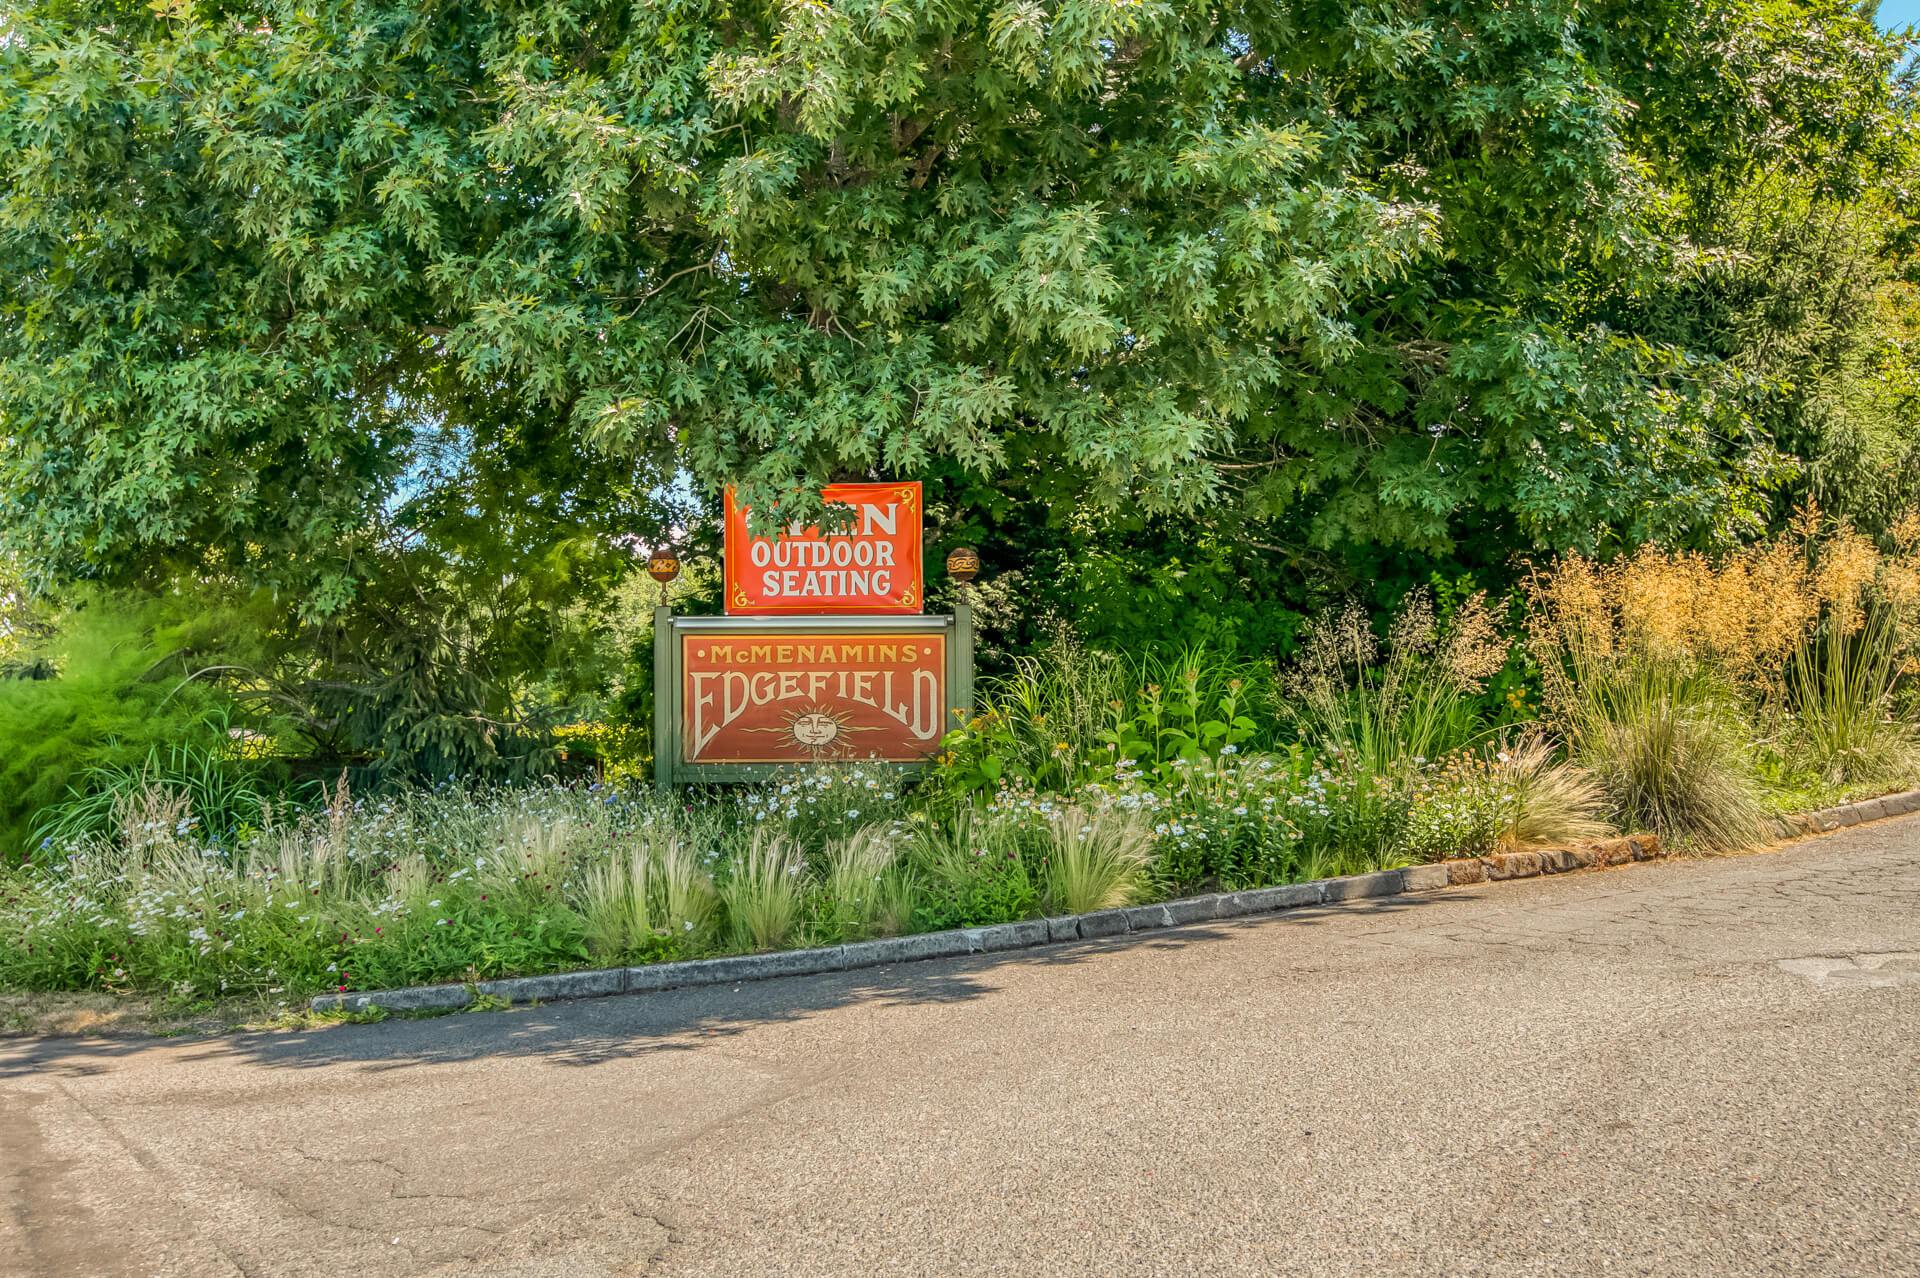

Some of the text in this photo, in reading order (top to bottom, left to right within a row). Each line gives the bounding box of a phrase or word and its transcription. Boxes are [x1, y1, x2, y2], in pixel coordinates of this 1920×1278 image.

[751, 541, 896, 567] OUTDOOR
[762, 570, 891, 597] SEATING
[710, 644, 918, 664] McMENAMINS
[689, 667, 938, 761] EDGEFIELD
